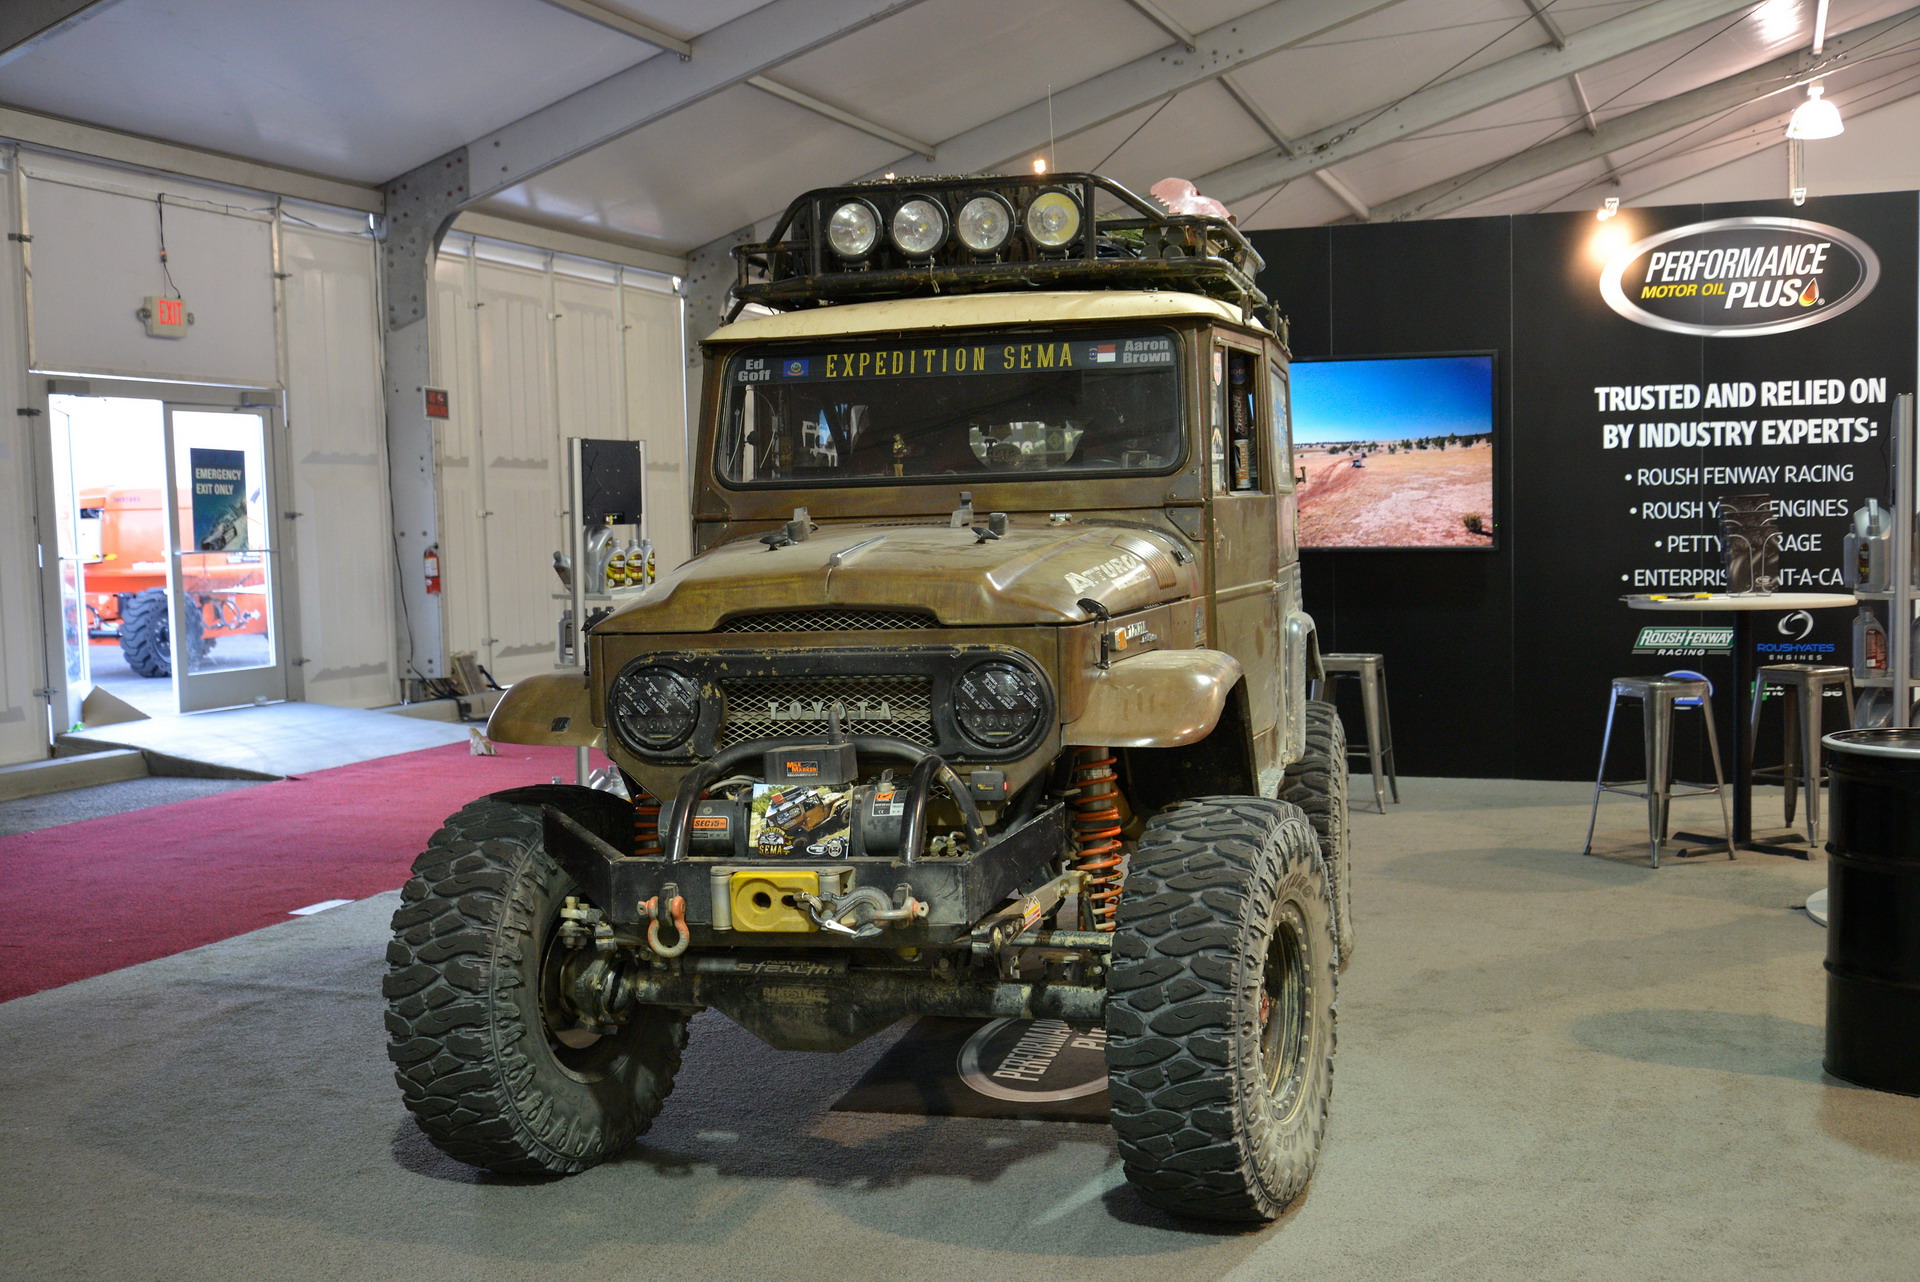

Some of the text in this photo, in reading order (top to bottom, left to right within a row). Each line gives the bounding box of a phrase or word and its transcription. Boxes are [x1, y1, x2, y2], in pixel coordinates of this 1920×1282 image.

[1645, 243, 1831, 283] PERFORMANCE
[1641, 283, 1726, 299] MOTOR OIL
[1725, 277, 1801, 310] PLUS
[158, 300, 183, 327] EXIT
[1124, 340, 1169, 352] Aaron
[745, 358, 764, 370] Ed
[825, 343, 1074, 378] EXPEDITION SEMA
[1123, 352, 1171, 364] Brown
[738, 369, 771, 382] Goff
[1595, 378, 1887, 412] TRUSTED AND RELIED ON
[1603, 418, 1878, 449] BY INDUSTRY EXPERTS:
[195, 467, 242, 481] EMERGENCY
[1637, 464, 1854, 486] ROUSH FENWAY RACING
[196, 483, 234, 495] EXIT ONLY
[1642, 502, 1703, 519] ROUSH
[1771, 499, 1848, 518] ENGINES
[1064, 553, 1137, 595] ATTURO
[1634, 568, 1728, 587] ENTERPRIS
[1640, 629, 1733, 646] ROUSH FENWAY
[1657, 648, 1706, 656] RACING
[1756, 643, 1835, 653] ROUSHYATES
[759, 844, 783, 855] SEMA
